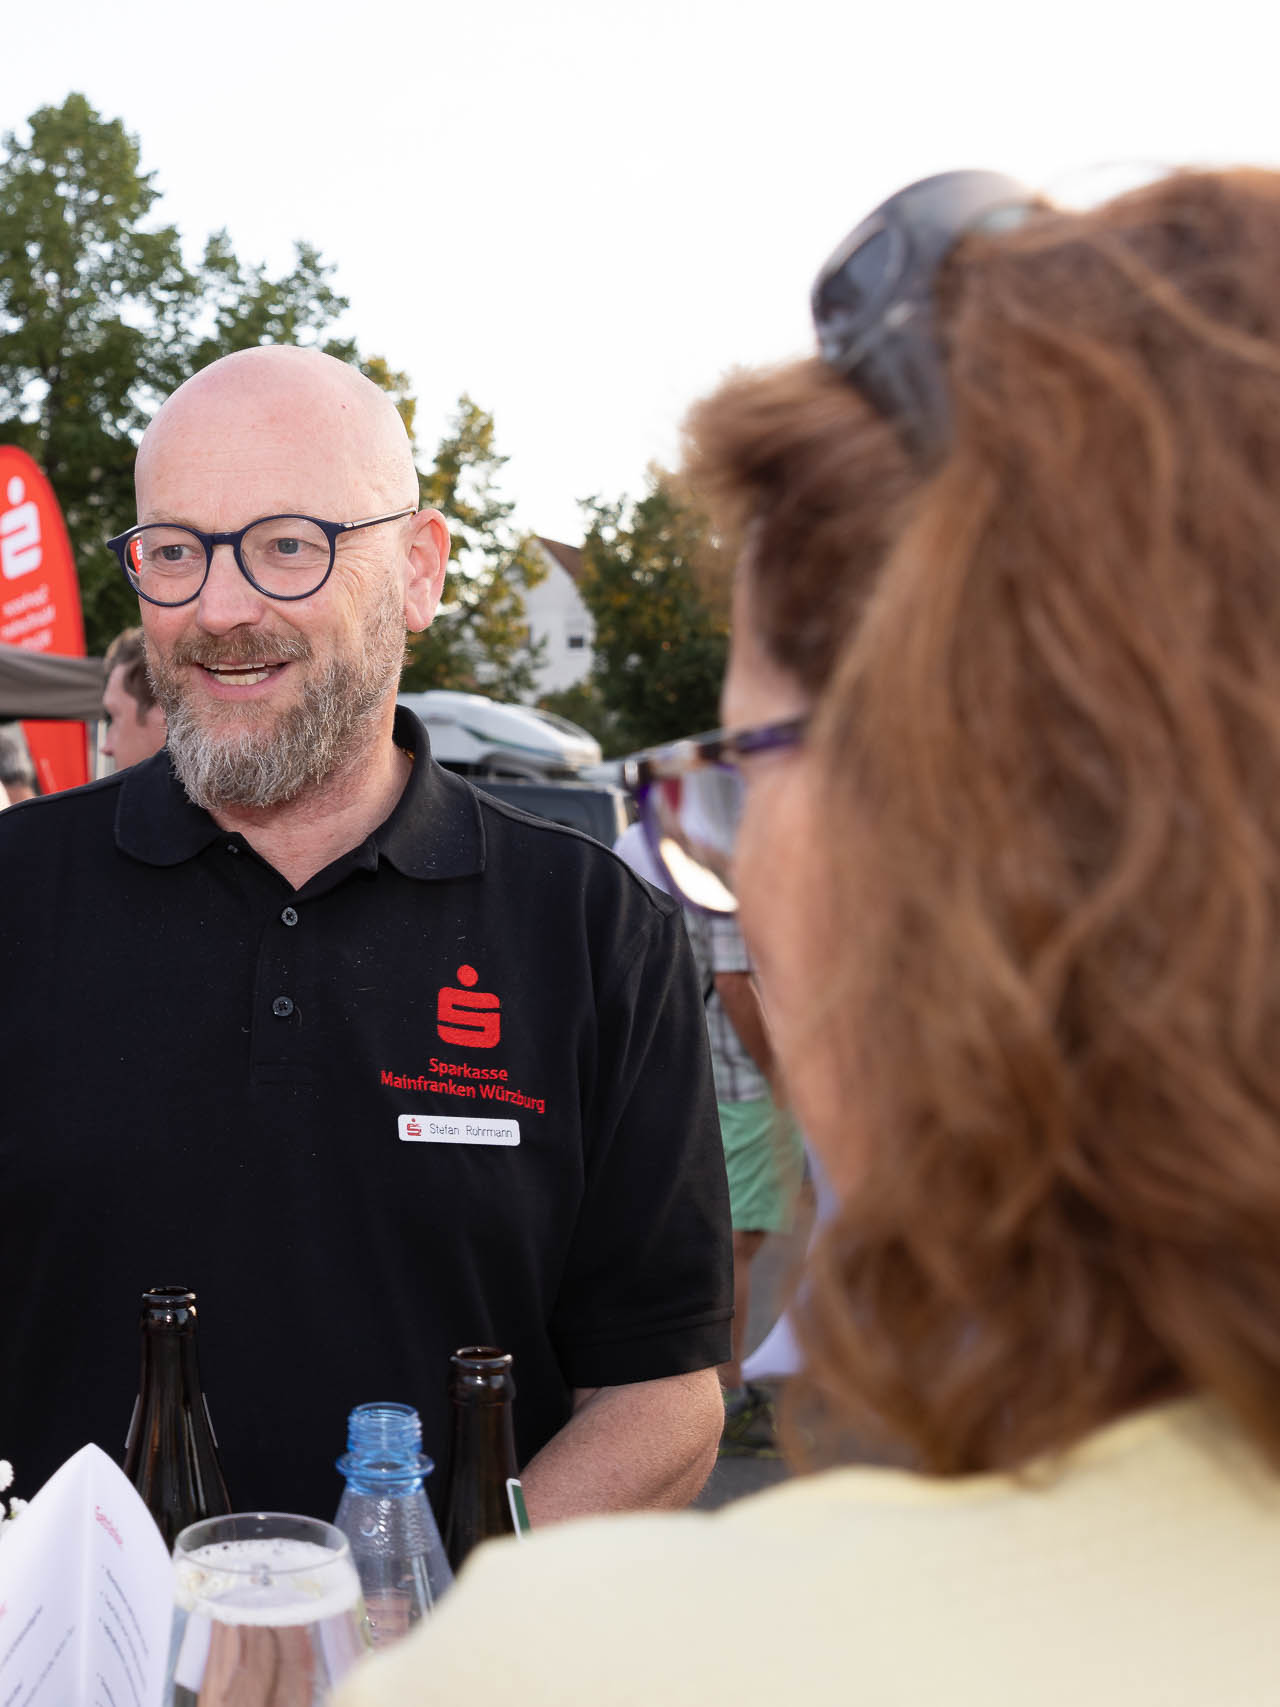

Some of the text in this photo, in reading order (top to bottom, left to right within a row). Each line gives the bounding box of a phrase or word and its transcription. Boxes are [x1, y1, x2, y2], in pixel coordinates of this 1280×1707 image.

[428, 1057, 509, 1081] Sparkasse
[380, 1069, 546, 1114] Mainfranken Würzburg
[429, 1123, 513, 1139] Stefan Rohrmann
